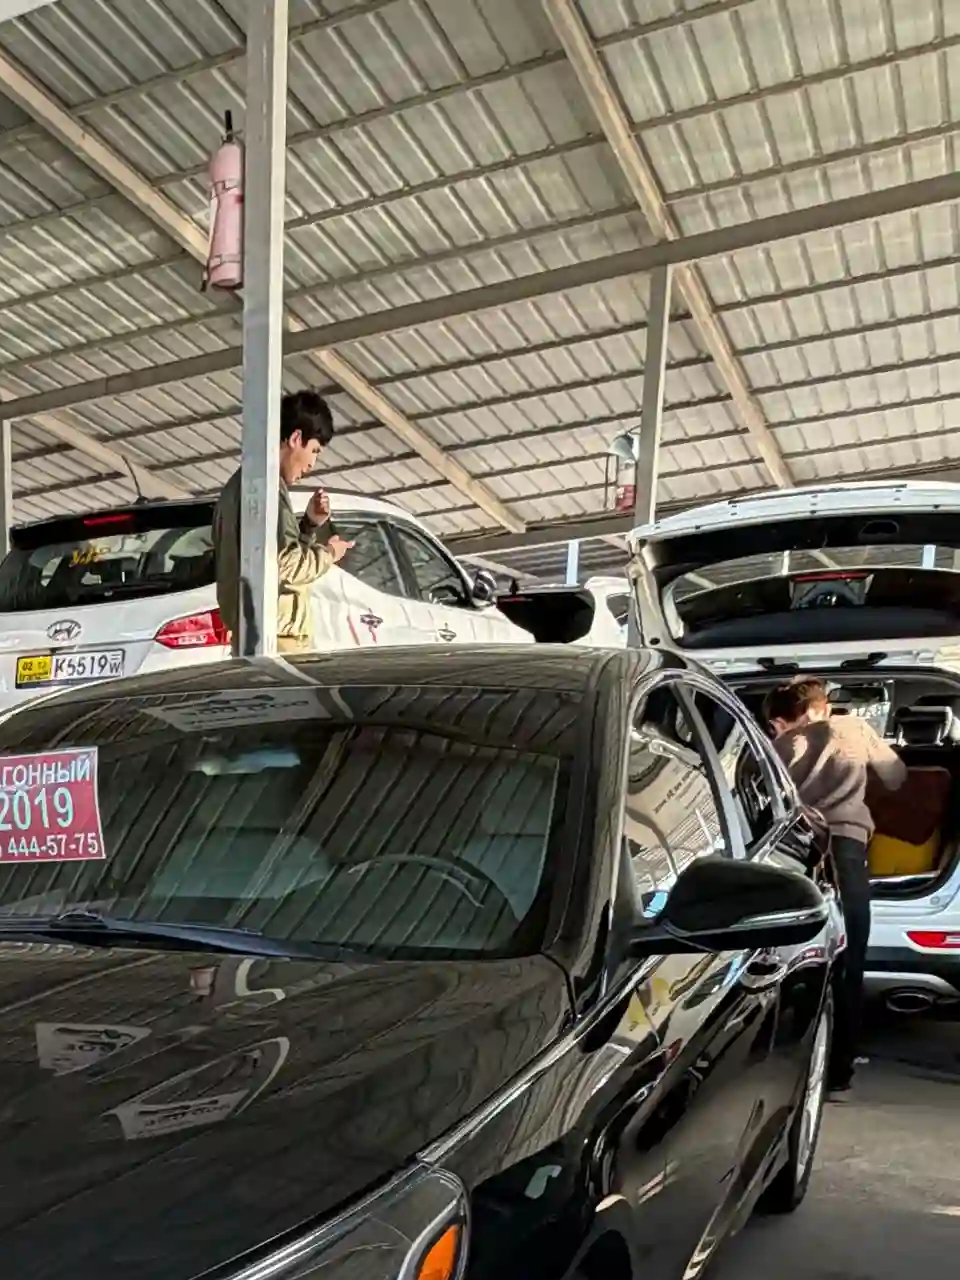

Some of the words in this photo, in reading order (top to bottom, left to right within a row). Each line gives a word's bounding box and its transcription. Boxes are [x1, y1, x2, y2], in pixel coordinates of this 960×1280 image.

[54, 654, 108, 679] K5519
[109, 661, 121, 674] W
[8, 832, 98, 857] 444-57-75
